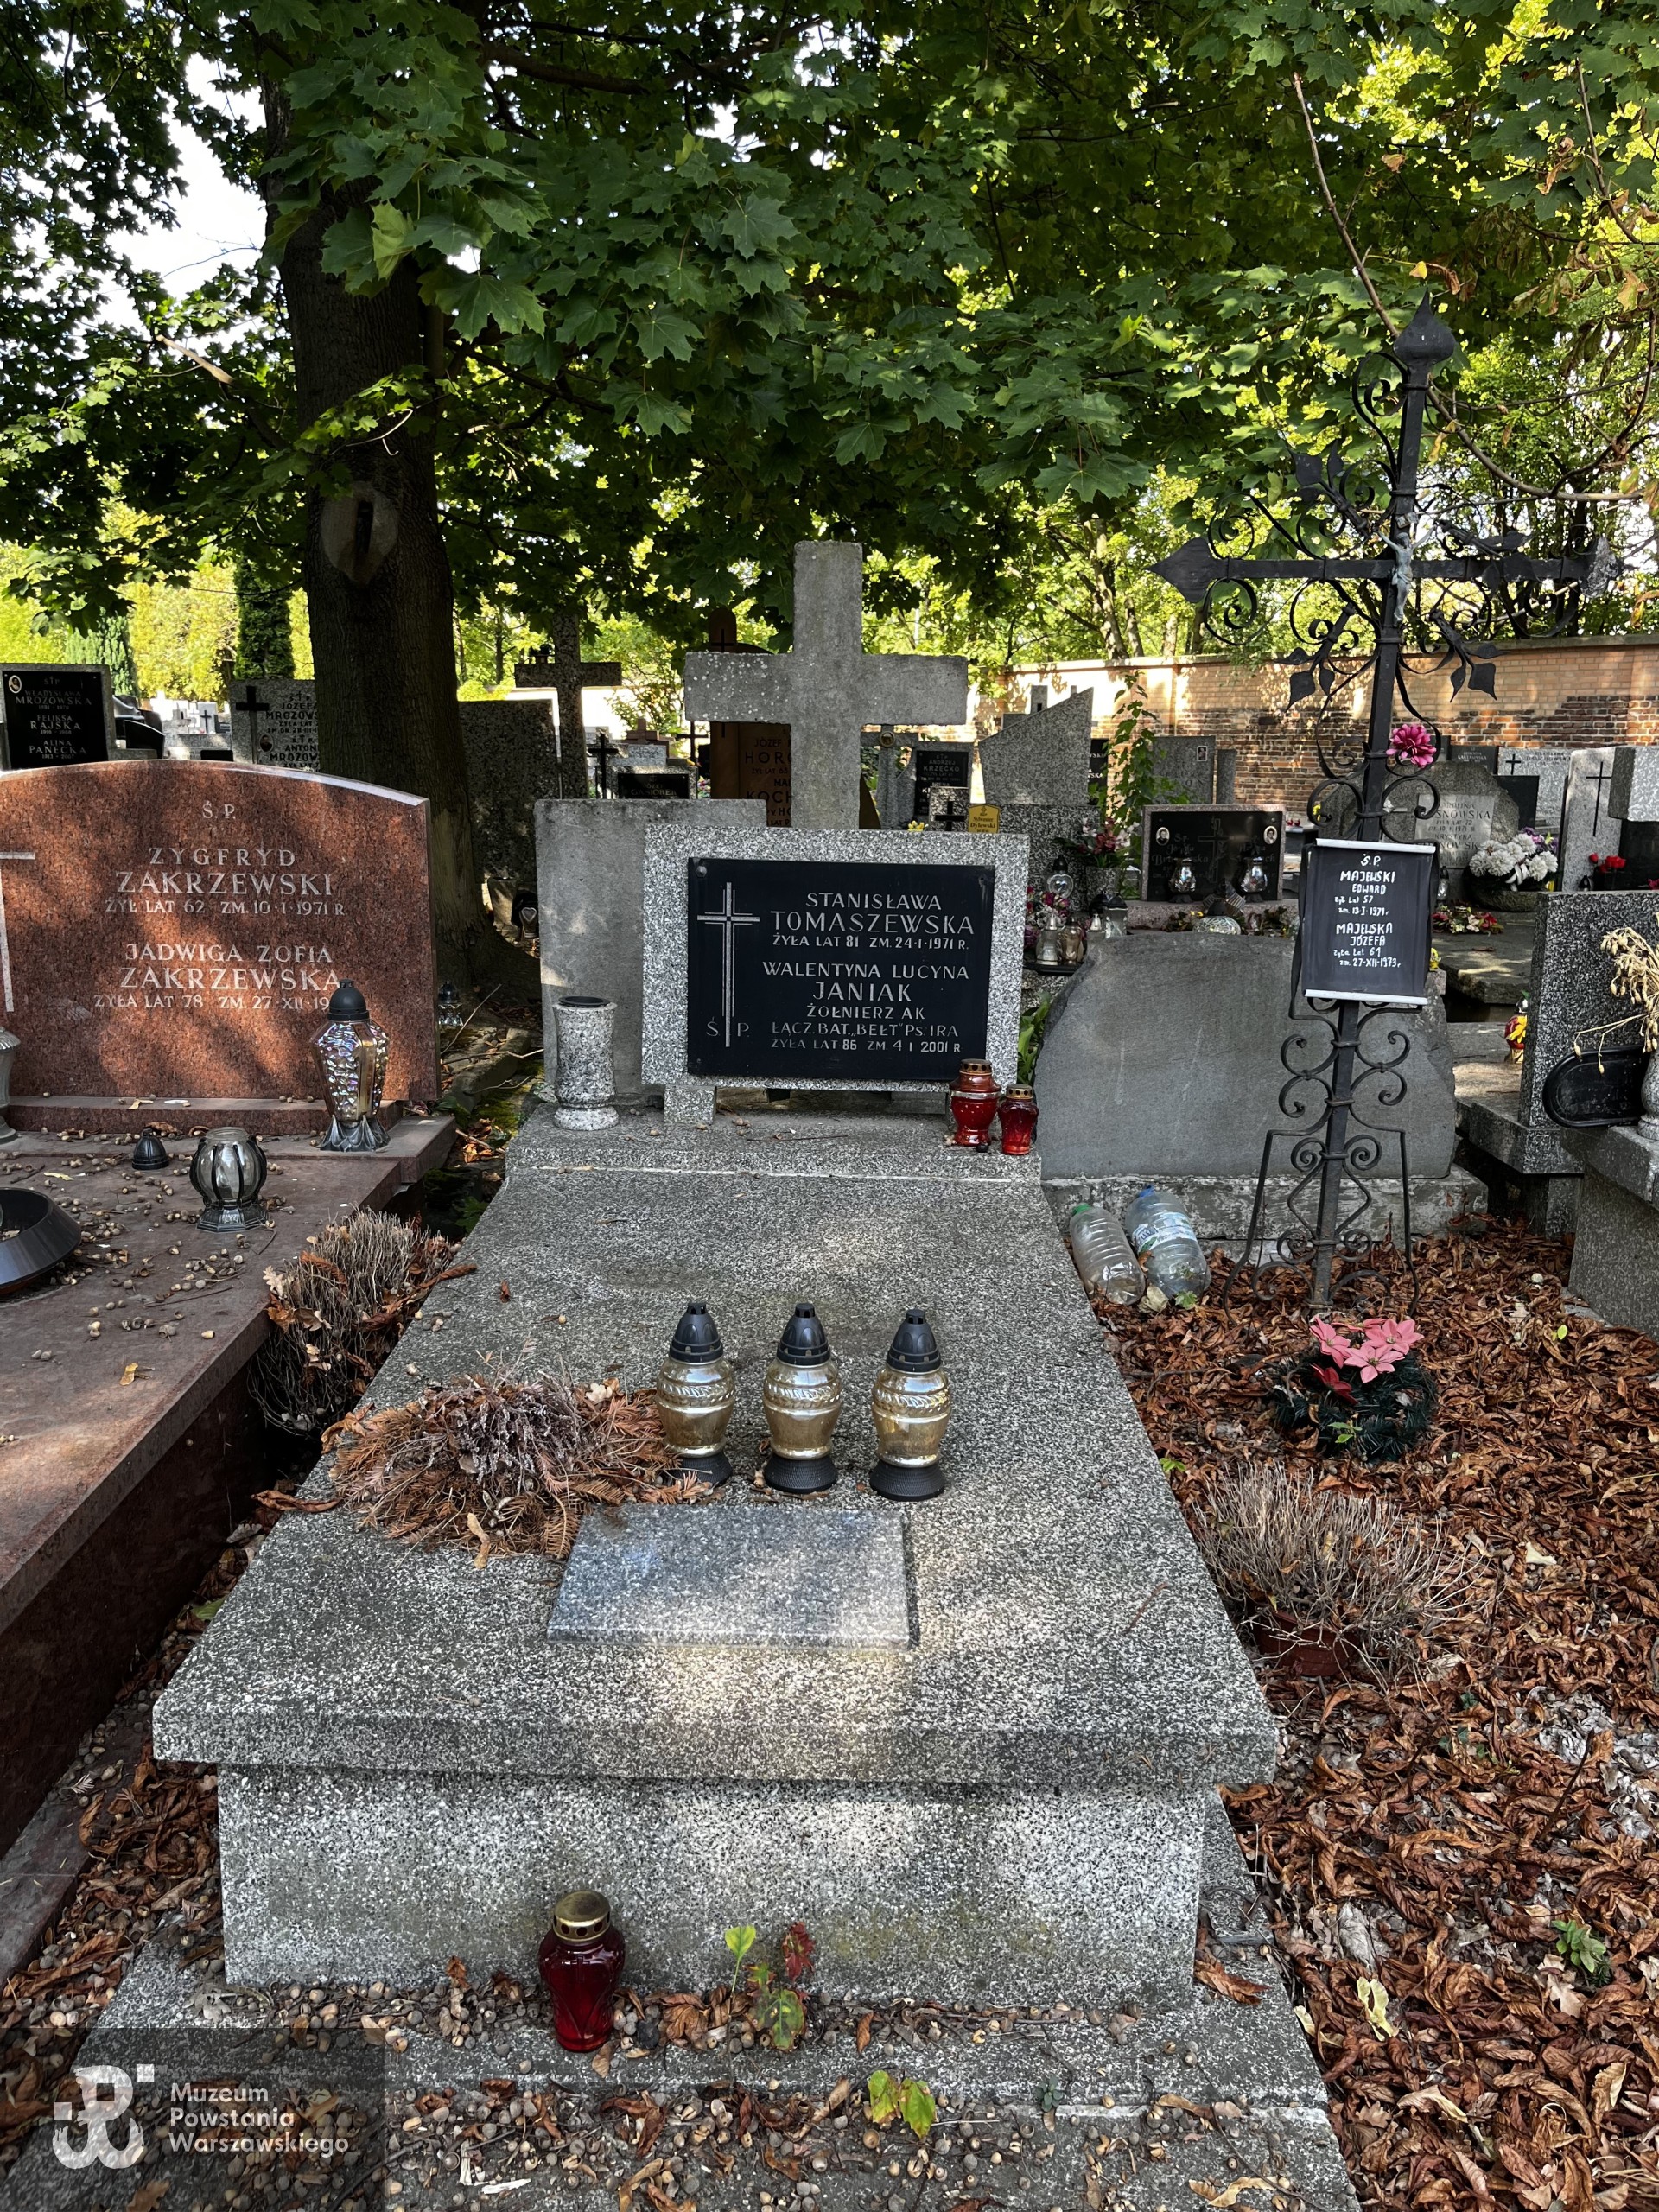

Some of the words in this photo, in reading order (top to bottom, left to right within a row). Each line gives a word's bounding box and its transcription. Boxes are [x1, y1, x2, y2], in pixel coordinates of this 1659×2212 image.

[266, 711, 319, 720] MROZOWS
[29, 721, 81, 730] RAJSKA
[29, 746, 87, 754] PANECKA
[149, 847, 296, 867] ZYGFRYD
[115, 871, 333, 896] ZAKRZEWSKI
[1339, 870, 1396, 883] MAJEWSKI
[1351, 883, 1387, 895] EDWARD
[145, 899, 175, 913] LAT
[184, 900, 206, 913] 62
[220, 901, 250, 914] ZM.
[805, 892, 943, 911] STANISŁAWA
[1363, 895, 1374, 904] 57
[771, 911, 975, 935] TOMASZEWSKA
[1336, 922, 1394, 935] MAJEWSKA
[772, 932, 810, 947] ŻYŁA
[816, 936, 842, 948] LAT
[847, 935, 860, 948] 81
[869, 937, 893, 949] ZM.
[958, 940, 969, 950] R.
[1349, 934, 1386, 947] JÓZEFA
[125, 943, 244, 962] JADWIGA
[257, 944, 333, 963] ZOFIA
[119, 966, 342, 990] ZAKRZEWSKA
[762, 962, 882, 979] WALENTYNA
[892, 964, 969, 980] LUCYNA
[812, 982, 912, 1002] JANIAK
[144, 995, 175, 1008] LAT
[182, 995, 204, 1008] 78
[219, 996, 247, 1009] ZM.
[806, 1003, 894, 1020] ŻOŁNIERZ
[901, 1007, 925, 1020] AK
[930, 1025, 959, 1037] IRA
[813, 1039, 838, 1050] LAT
[842, 1039, 857, 1051] 86
[892, 1039, 902, 1052] 4
[920, 1040, 947, 1052] 2001
